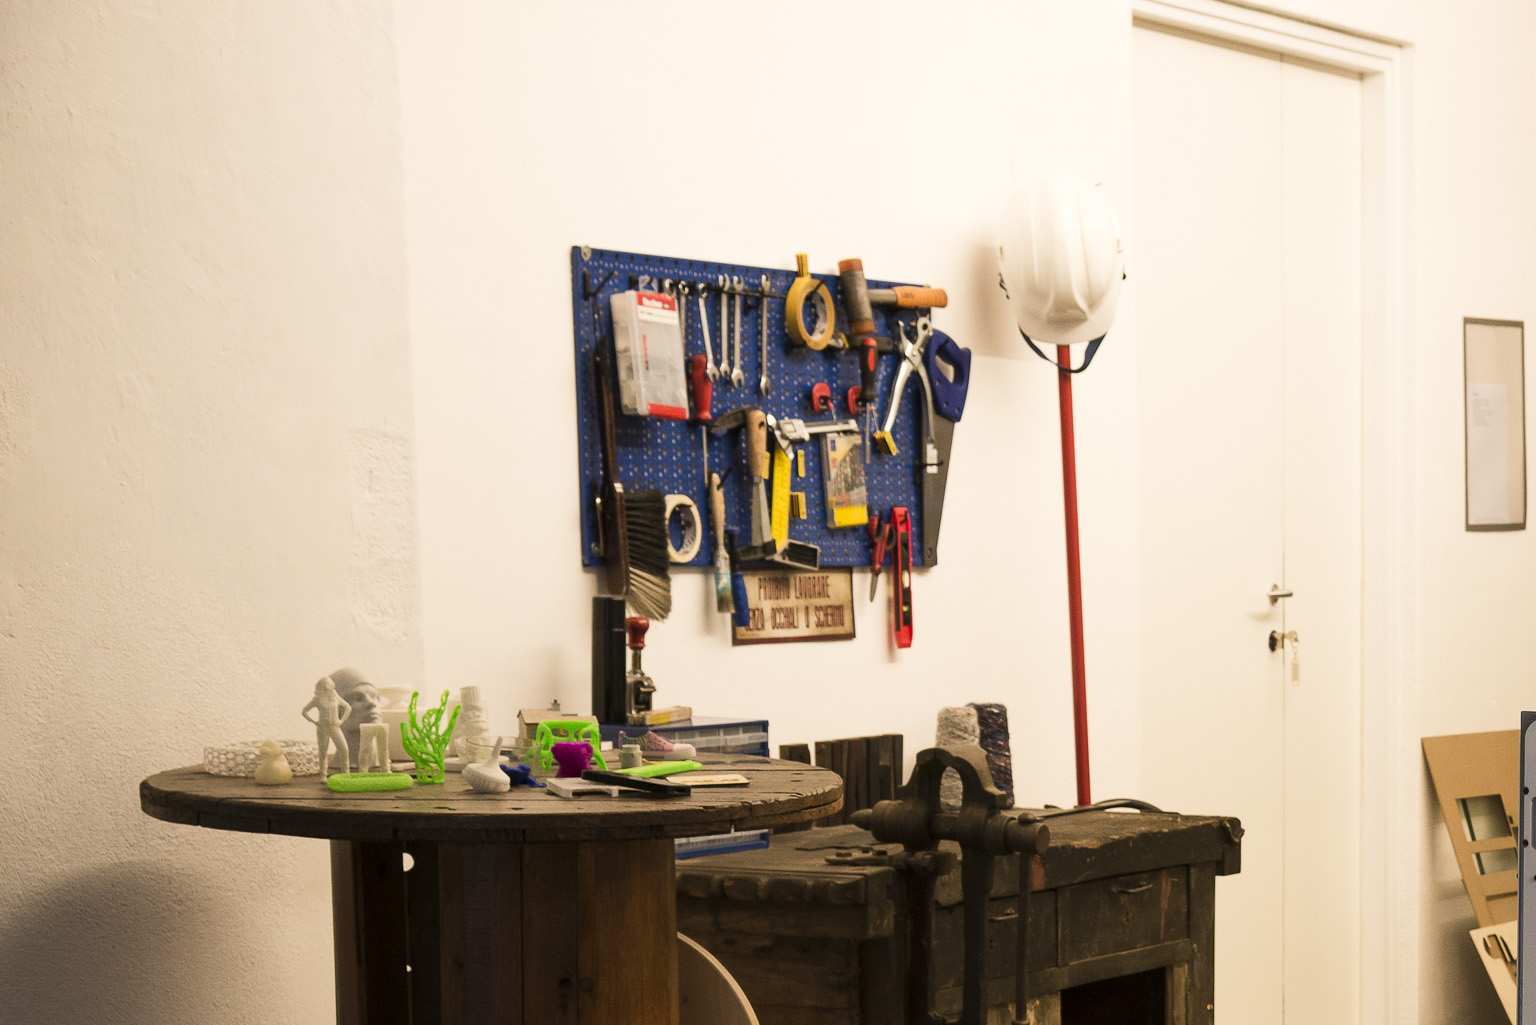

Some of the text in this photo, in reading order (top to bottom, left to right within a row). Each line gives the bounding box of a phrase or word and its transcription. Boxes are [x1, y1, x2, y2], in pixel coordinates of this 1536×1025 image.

[794, 575, 830, 599] LAVORARE
[770, 606, 798, 630] OCCHIALI
[814, 604, 844, 628] SCHERMO
